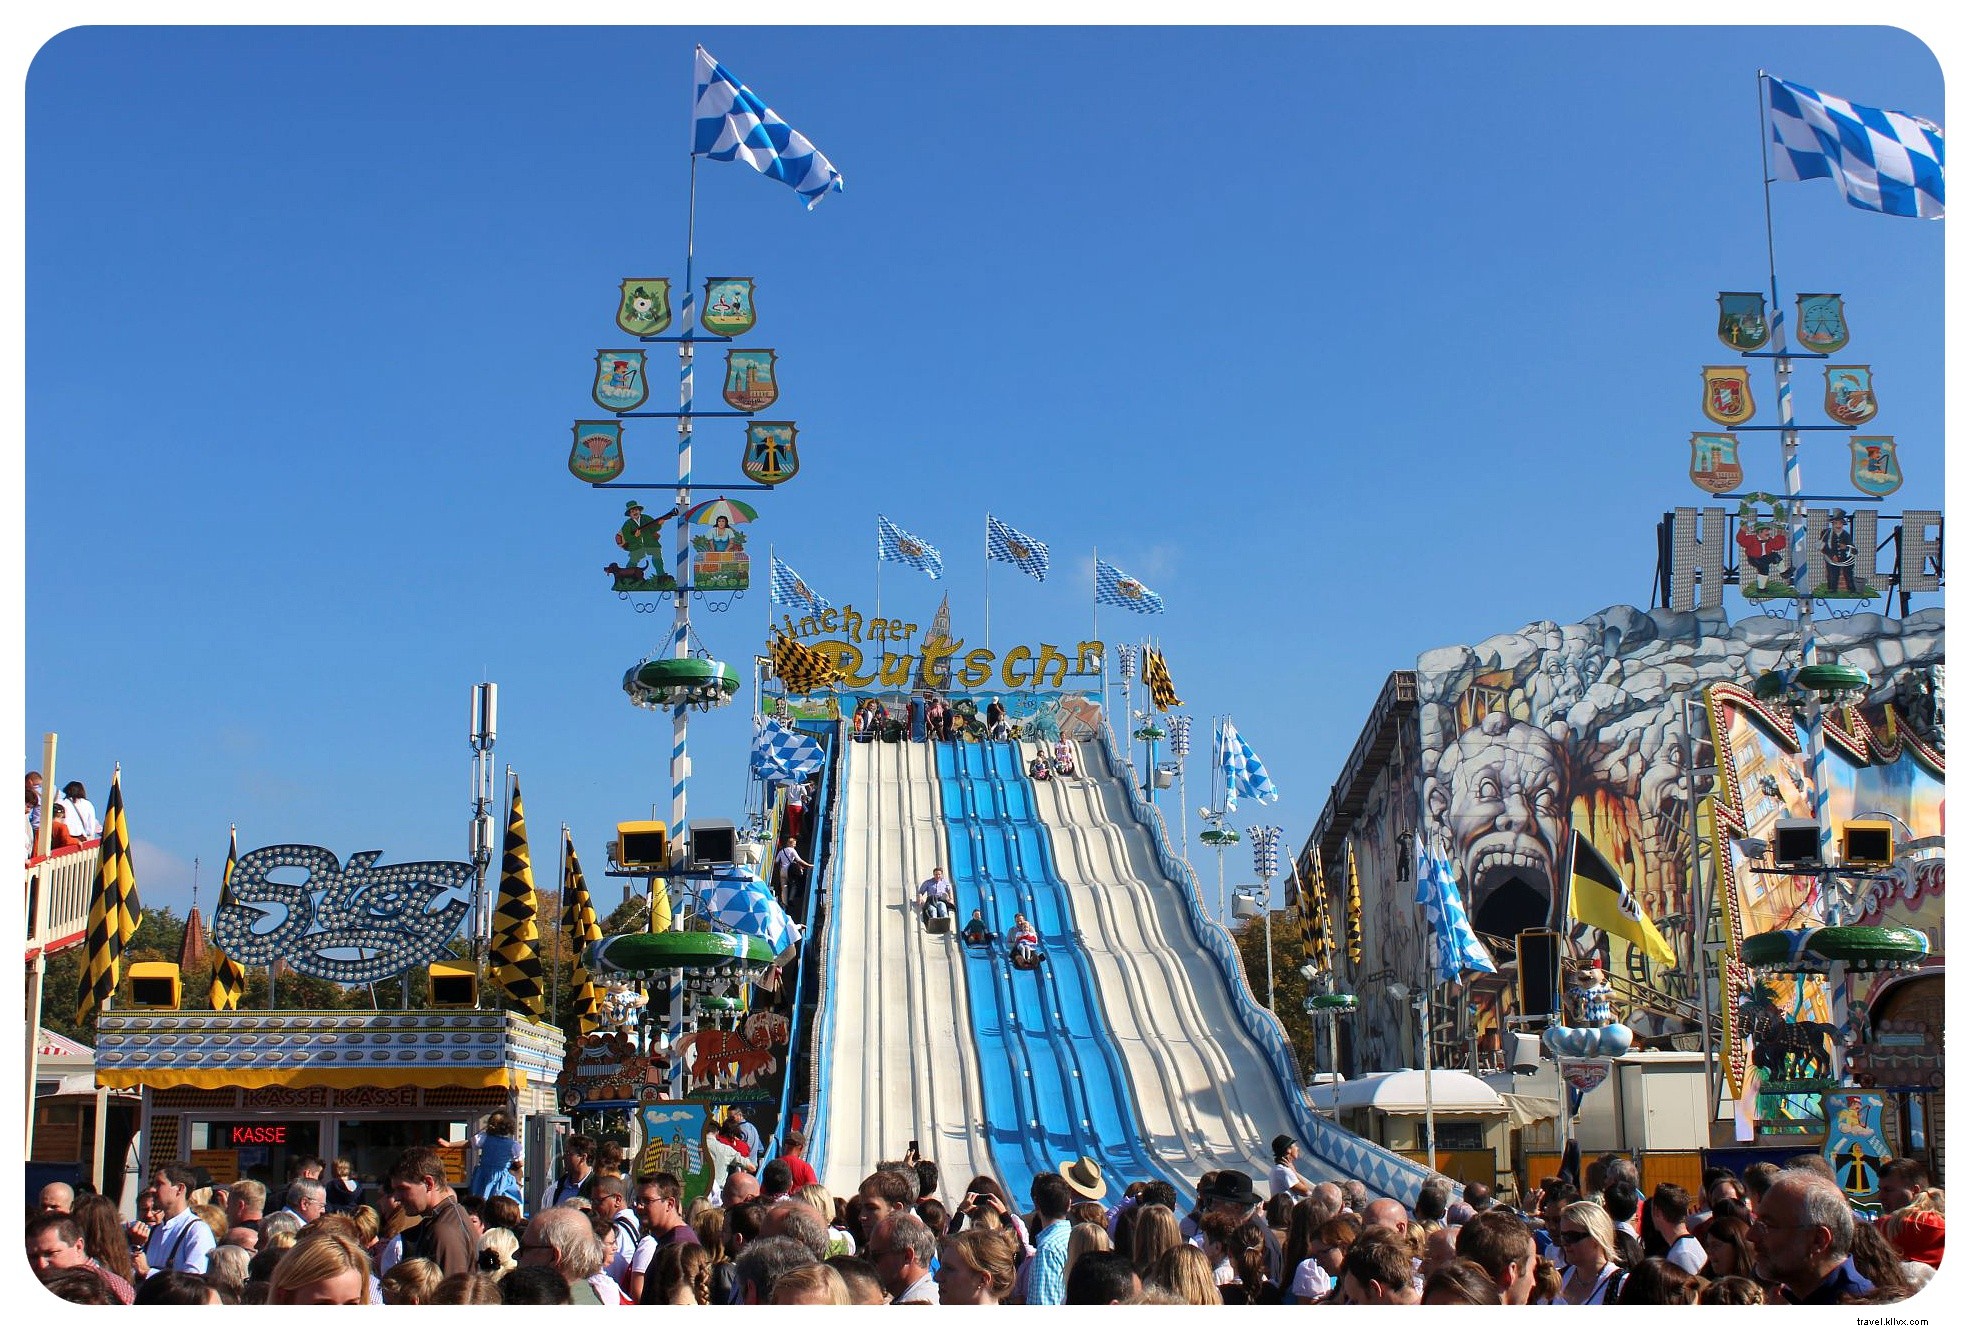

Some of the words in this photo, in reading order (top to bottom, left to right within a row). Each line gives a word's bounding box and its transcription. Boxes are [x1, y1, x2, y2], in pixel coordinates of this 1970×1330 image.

[248, 1088, 323, 1106] KASSE
[338, 1088, 412, 1106] KASSE
[232, 1126, 286, 1144] KASSE
